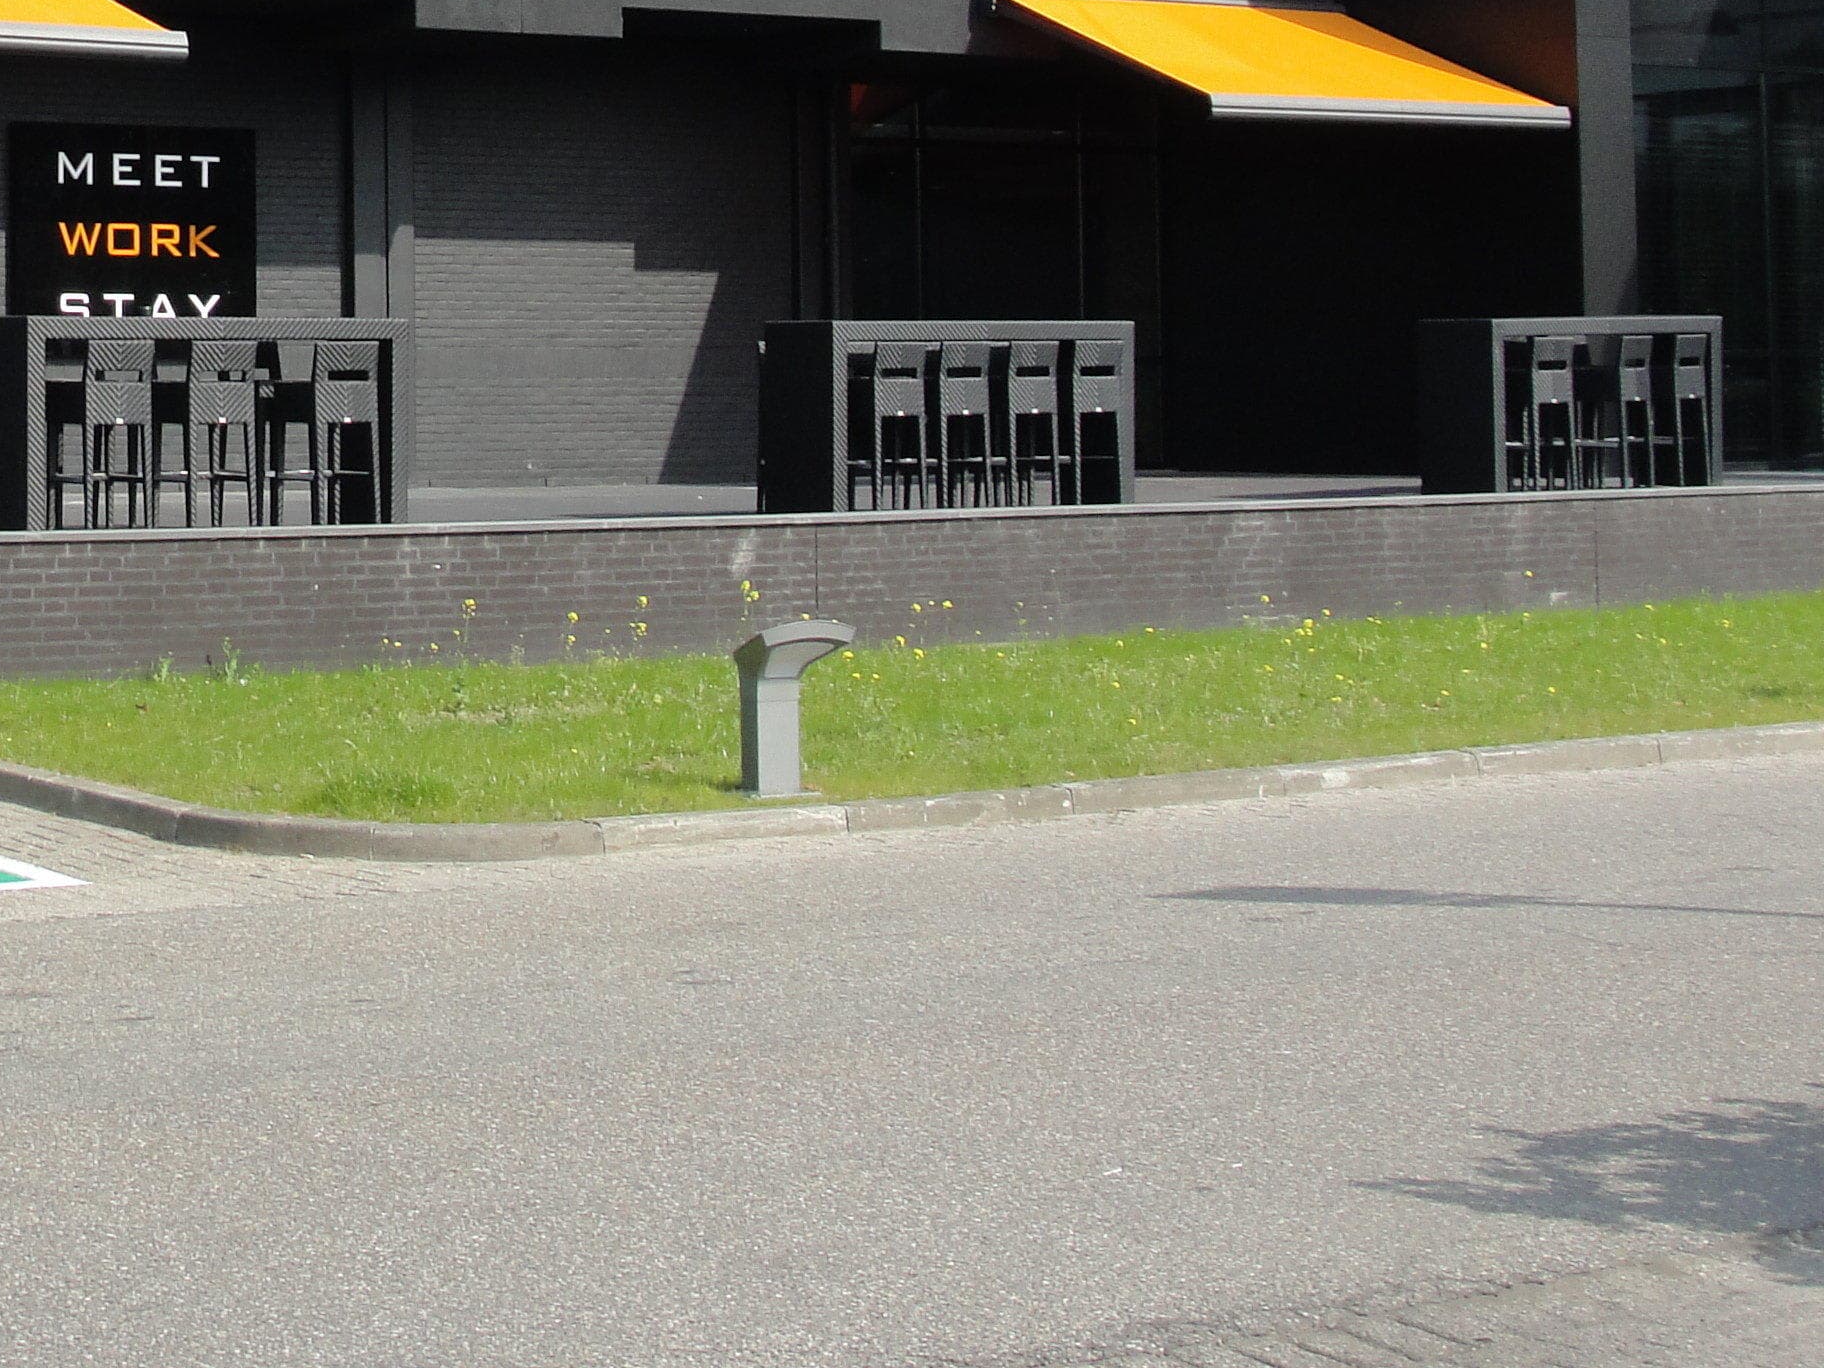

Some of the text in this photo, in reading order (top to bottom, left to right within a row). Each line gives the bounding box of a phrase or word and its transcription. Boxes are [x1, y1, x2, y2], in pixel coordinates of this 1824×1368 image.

[57, 151, 220, 188] MEET
[58, 222, 220, 258] WORK
[59, 293, 220, 318] STAY
